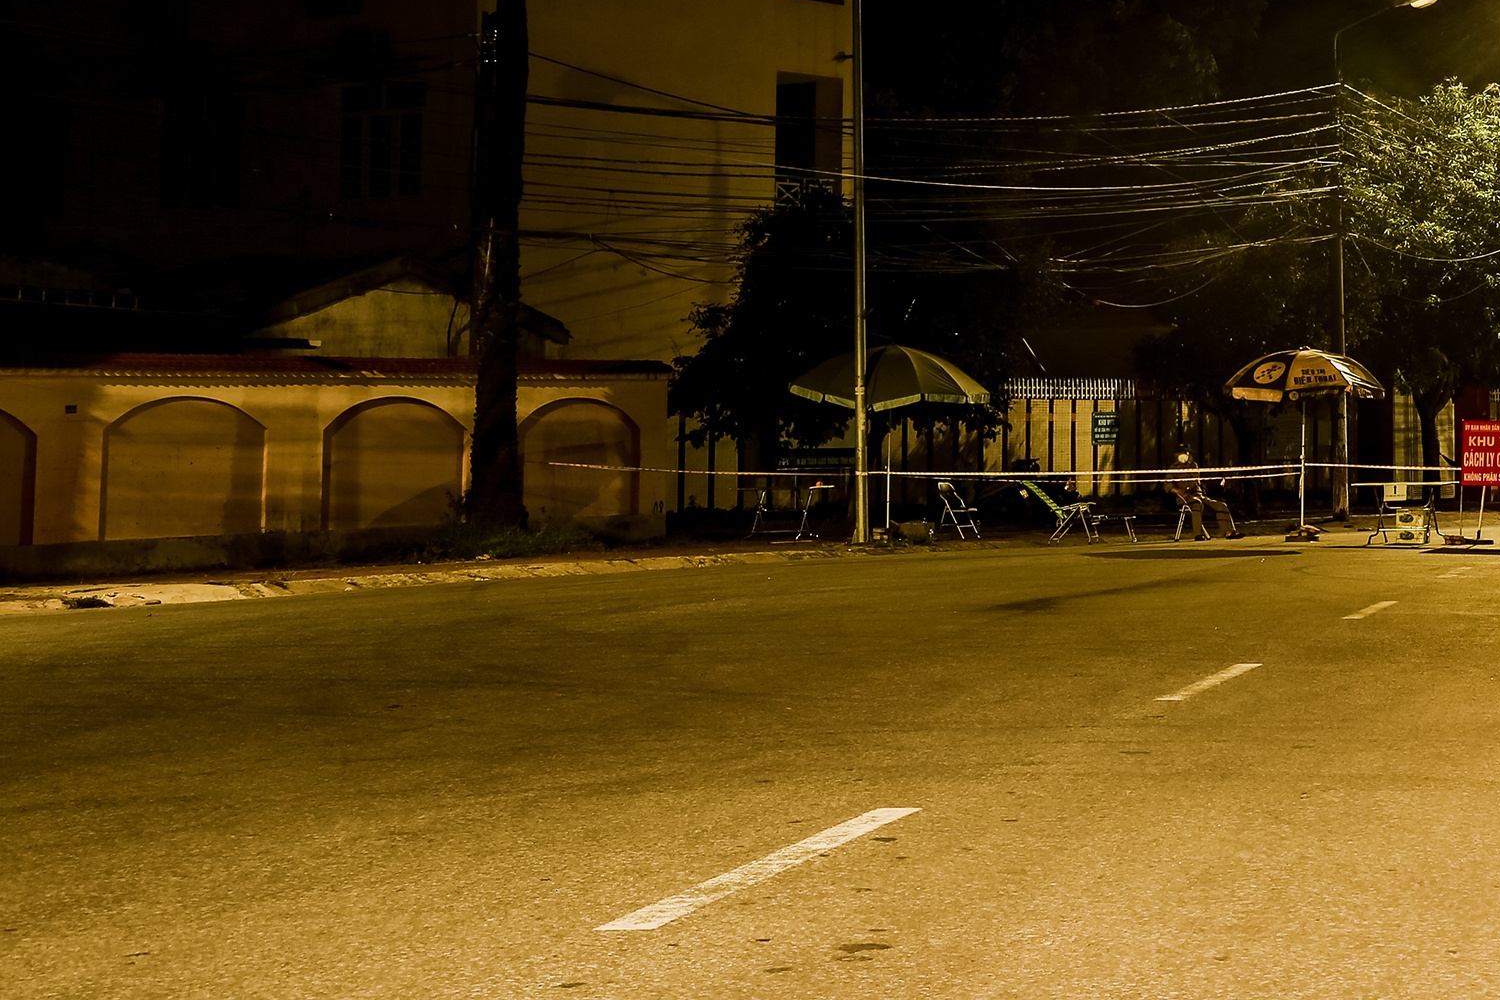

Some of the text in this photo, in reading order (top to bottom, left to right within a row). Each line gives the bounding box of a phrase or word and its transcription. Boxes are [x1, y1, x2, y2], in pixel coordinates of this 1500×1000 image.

[1468, 436, 1495, 447] KHU
[1463, 449, 1484, 467] CÁCH
[1486, 452, 1495, 467] LY
[1463, 471, 1482, 481] KHÔNG
[1482, 471, 1497, 484] PHẬN
